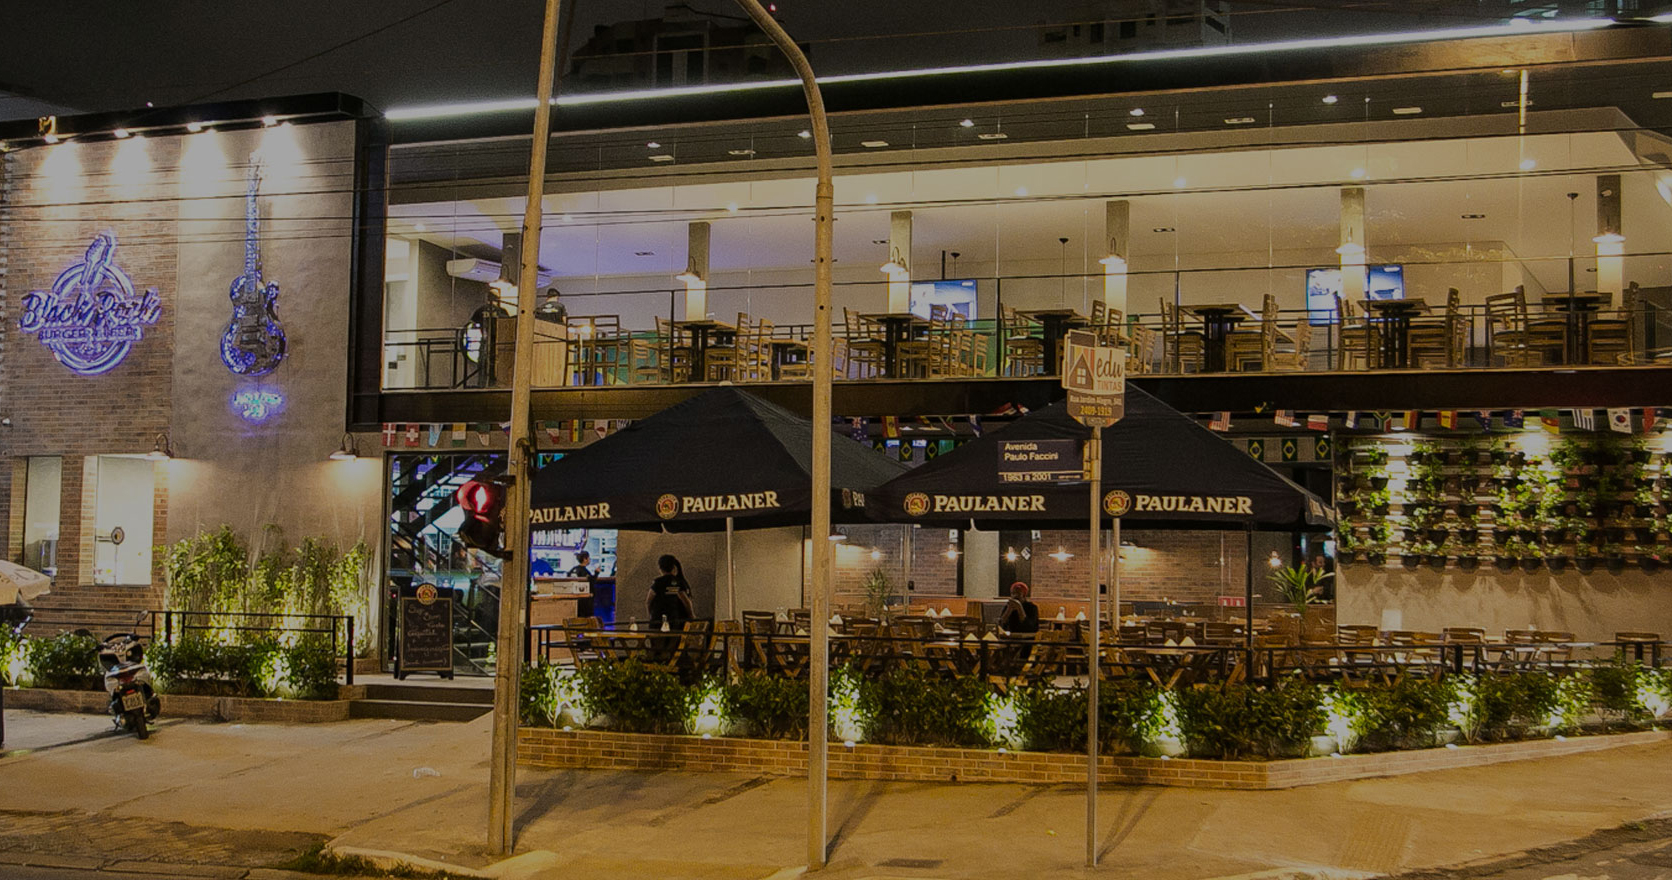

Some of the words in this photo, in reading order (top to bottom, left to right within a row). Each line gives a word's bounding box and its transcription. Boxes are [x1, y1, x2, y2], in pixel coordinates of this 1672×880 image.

[19, 291, 94, 328] Black
[38, 327, 87, 340] BURGER
[1096, 349, 1123, 378] edu
[1097, 380, 1123, 391] TINTAS
[1004, 443, 1038, 451] Avenida
[1004, 452, 1028, 461] Paulo
[1029, 451, 1059, 461] Faccini
[1032, 473, 1051, 481] 2001
[682, 490, 780, 513] PAULANER
[933, 494, 1046, 512] PAULANER
[1135, 494, 1254, 515] PAULANER
